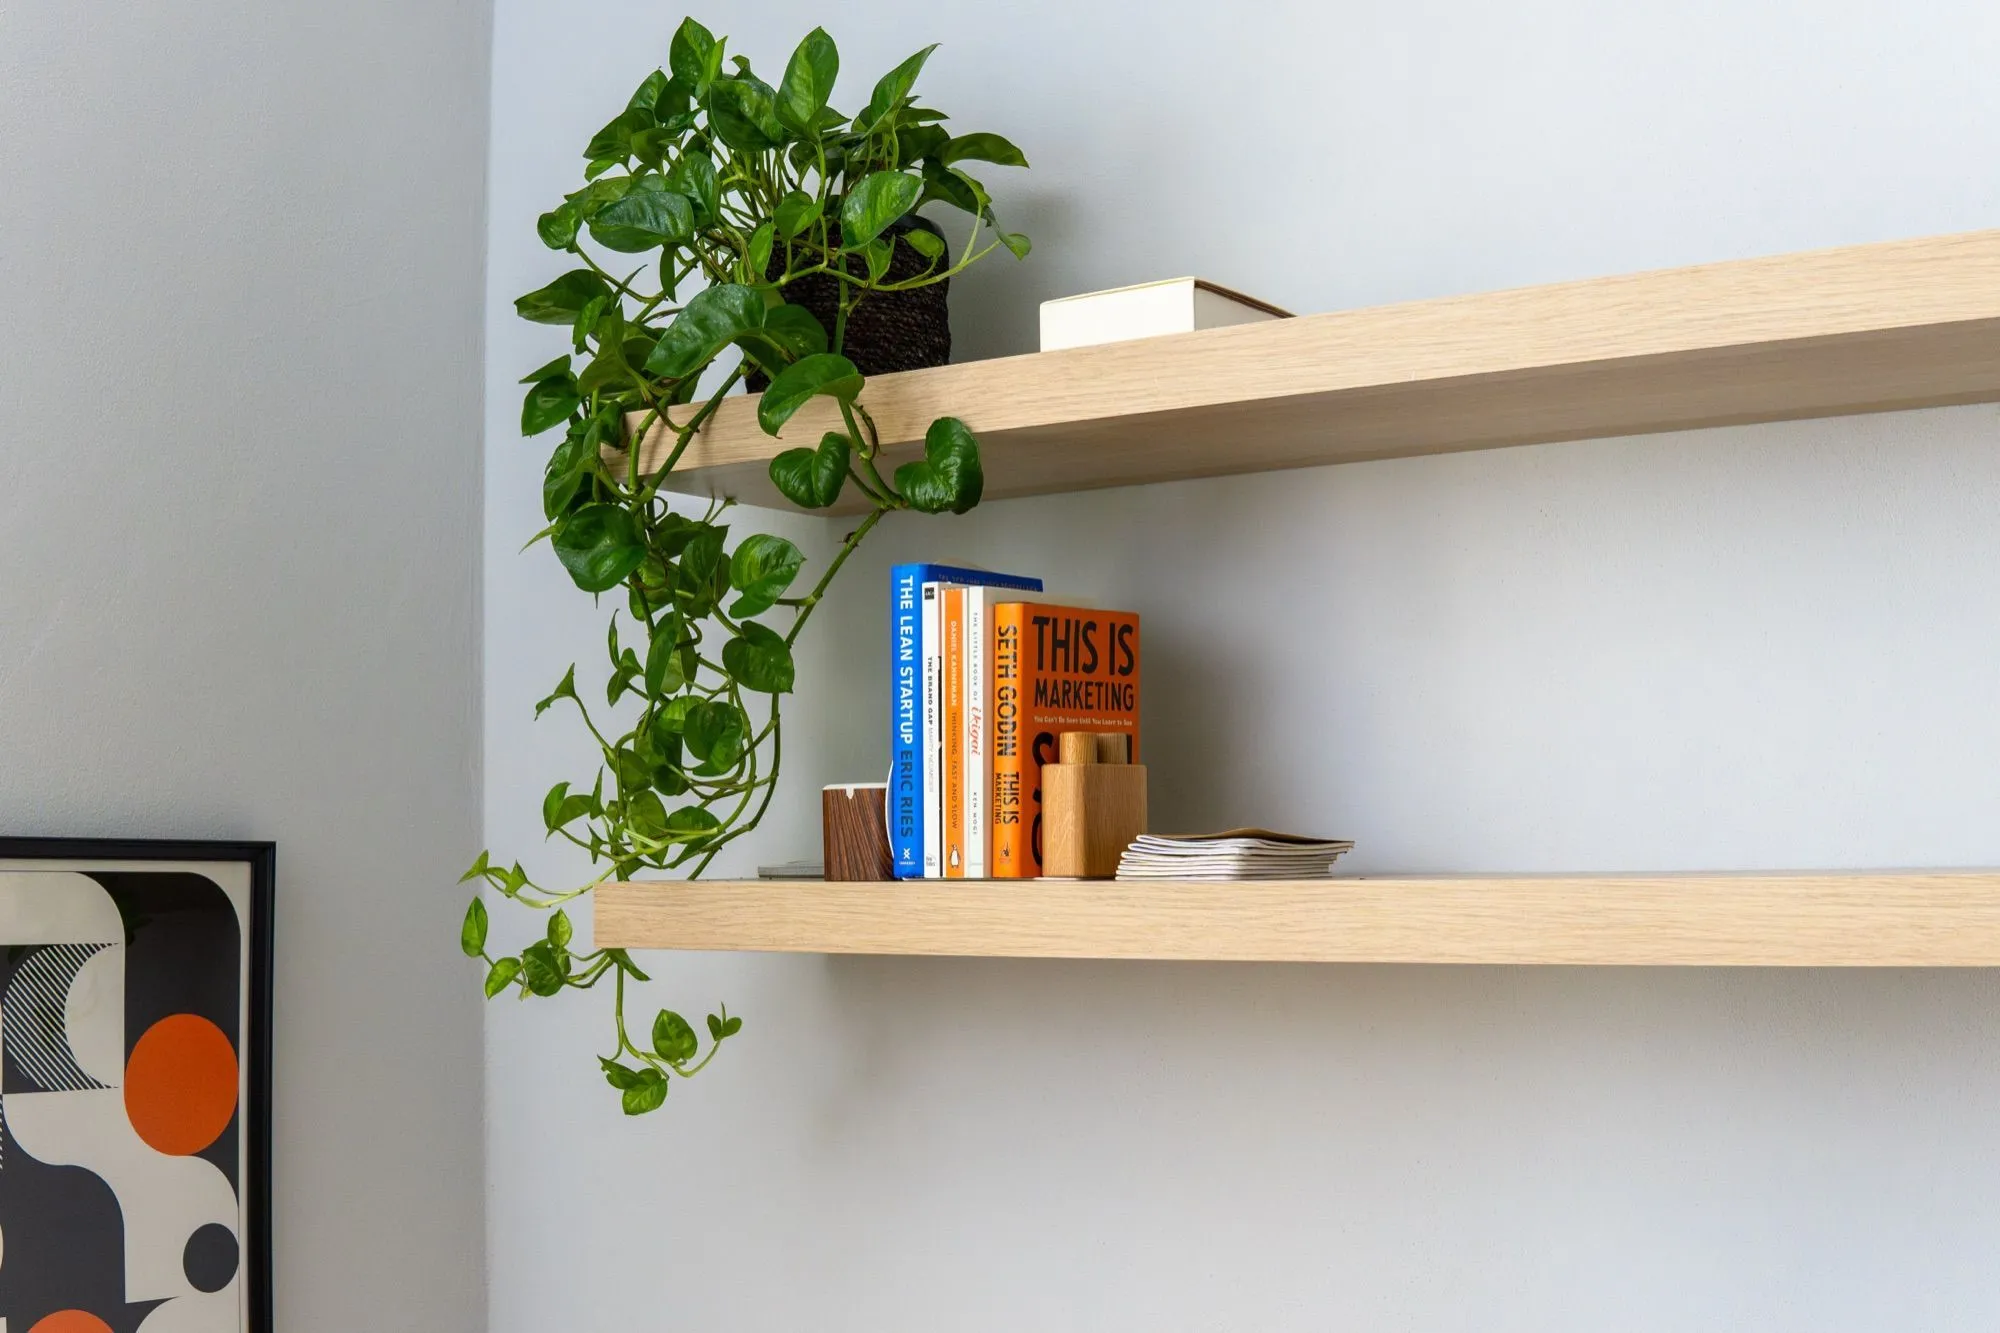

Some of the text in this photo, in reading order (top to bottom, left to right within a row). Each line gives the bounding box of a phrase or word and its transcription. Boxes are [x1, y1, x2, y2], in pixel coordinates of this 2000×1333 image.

[900, 575, 914, 744] THE LEAN STARTUP
[1031, 615, 1135, 677] THIS IS
[997, 625, 1017, 756] SETH GODIN
[1034, 678, 1134, 712] MARKETING
[900, 750, 914, 838] ERIC RIES
[1003, 772, 1019, 825] THIS IS
